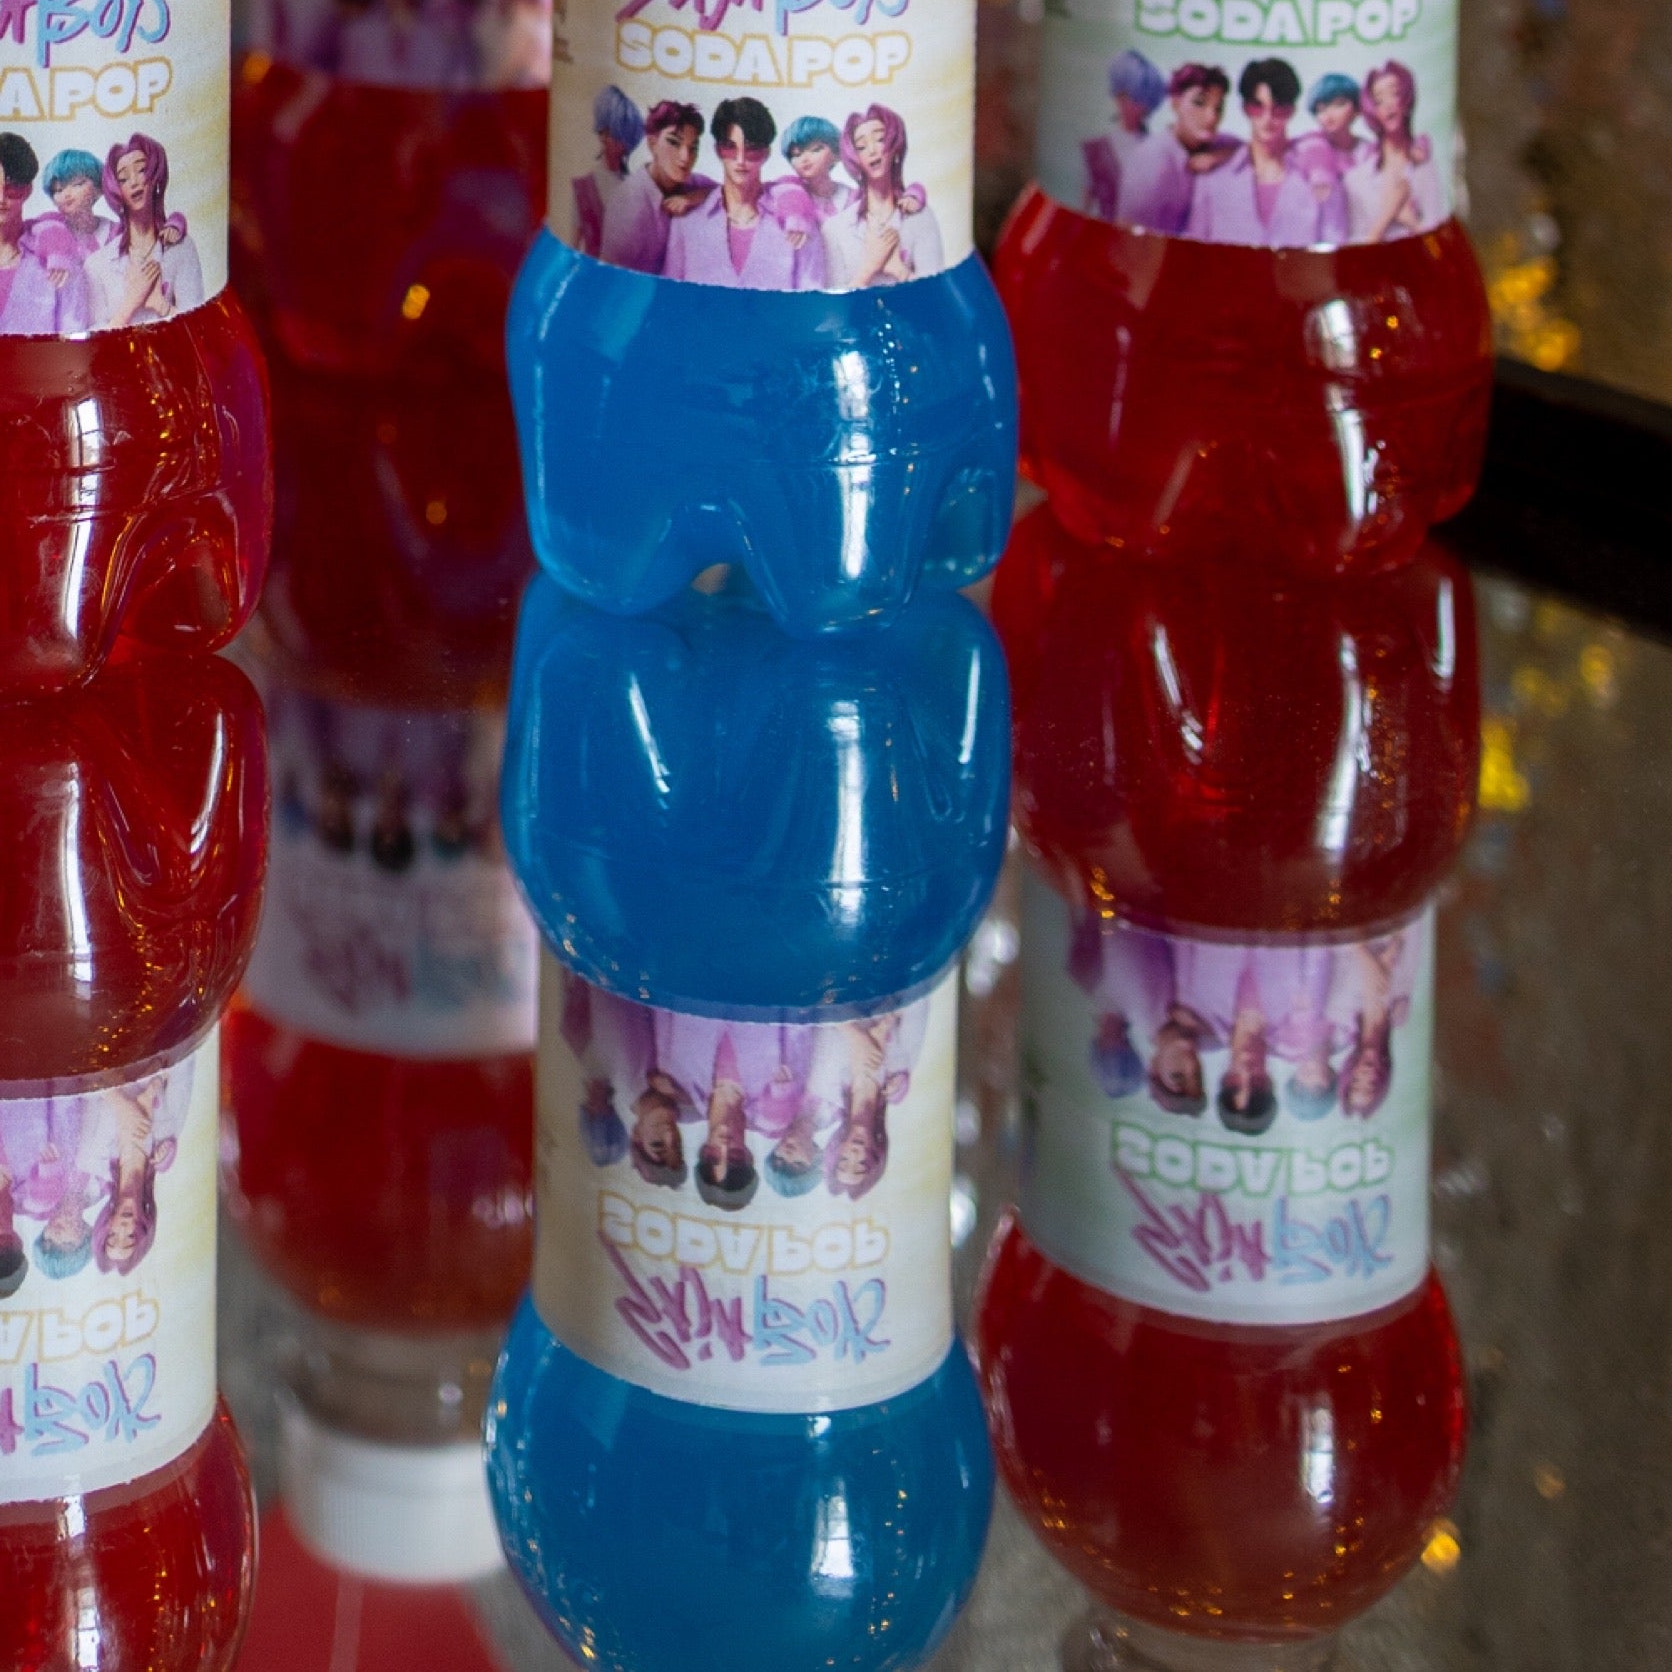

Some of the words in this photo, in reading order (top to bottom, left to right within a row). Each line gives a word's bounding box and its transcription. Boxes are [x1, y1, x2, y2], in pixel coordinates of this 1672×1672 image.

[615, 18, 786, 87] SODA
[786, 31, 912, 87] POP
[48, 57, 173, 121] POP
